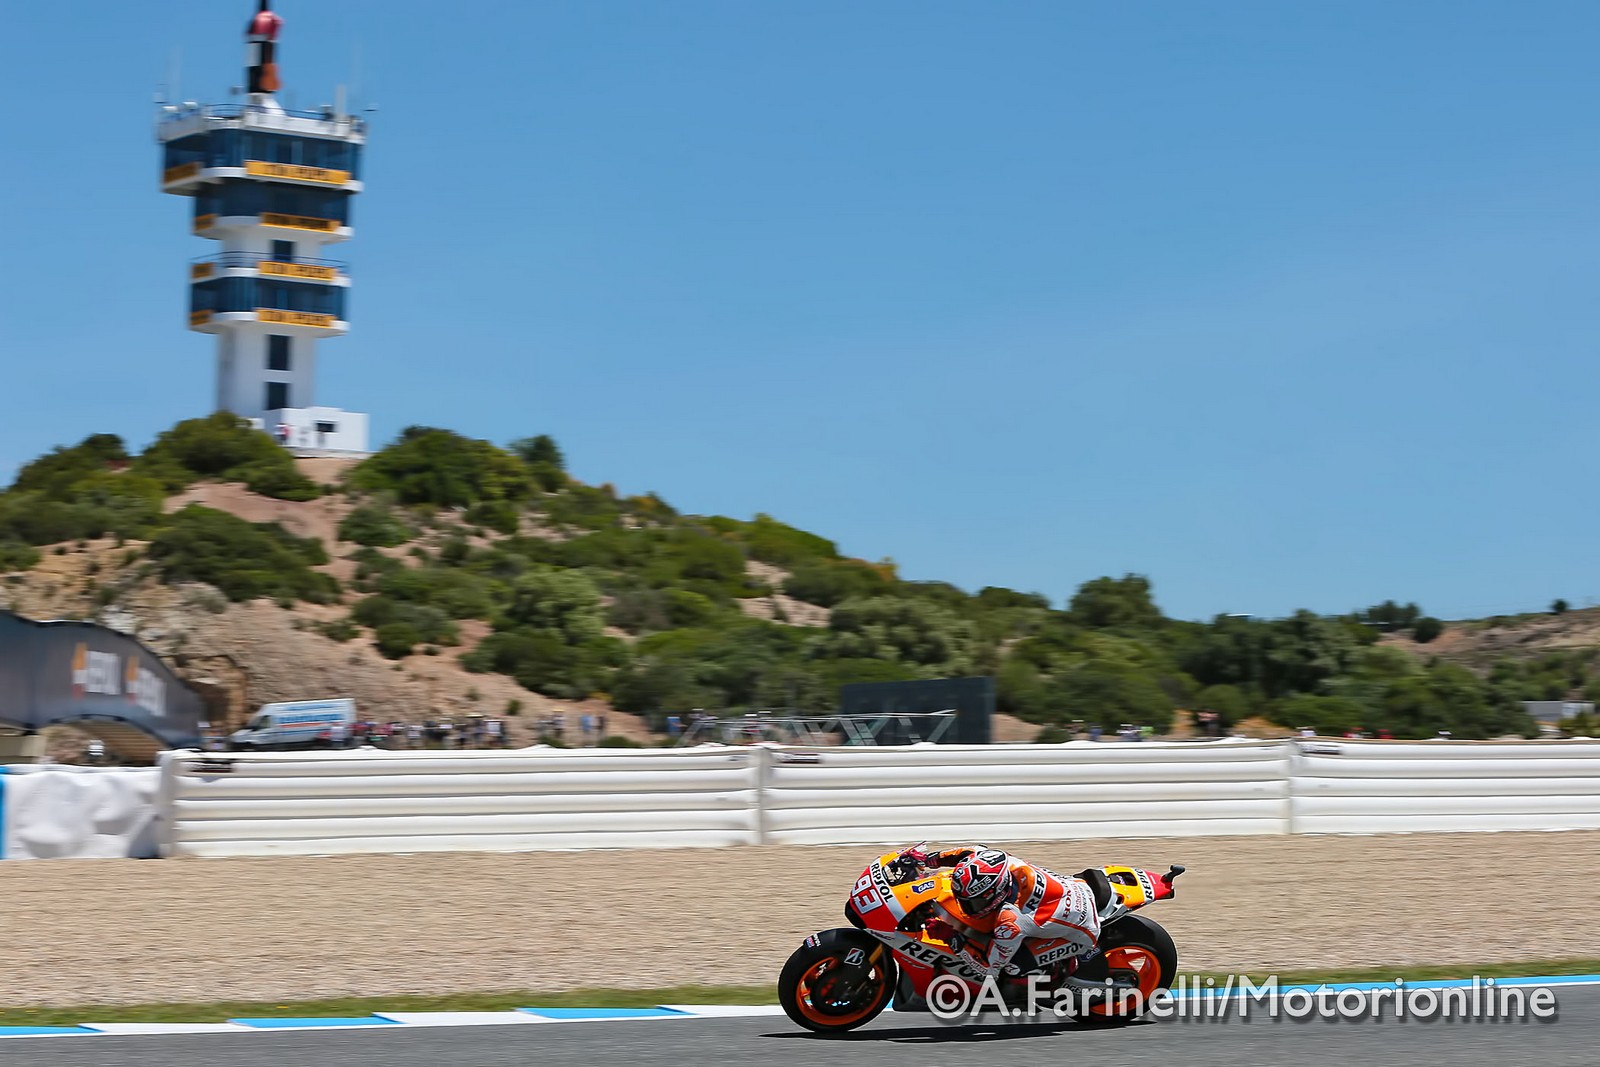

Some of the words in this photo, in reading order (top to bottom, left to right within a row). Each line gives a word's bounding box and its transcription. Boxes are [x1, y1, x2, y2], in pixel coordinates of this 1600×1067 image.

[851, 873, 884, 915] 93
[870, 862, 894, 903] REPSOL
[917, 880, 935, 893] GAS
[968, 876, 992, 895] LOTUS
[1038, 941, 1083, 965] REPSO
